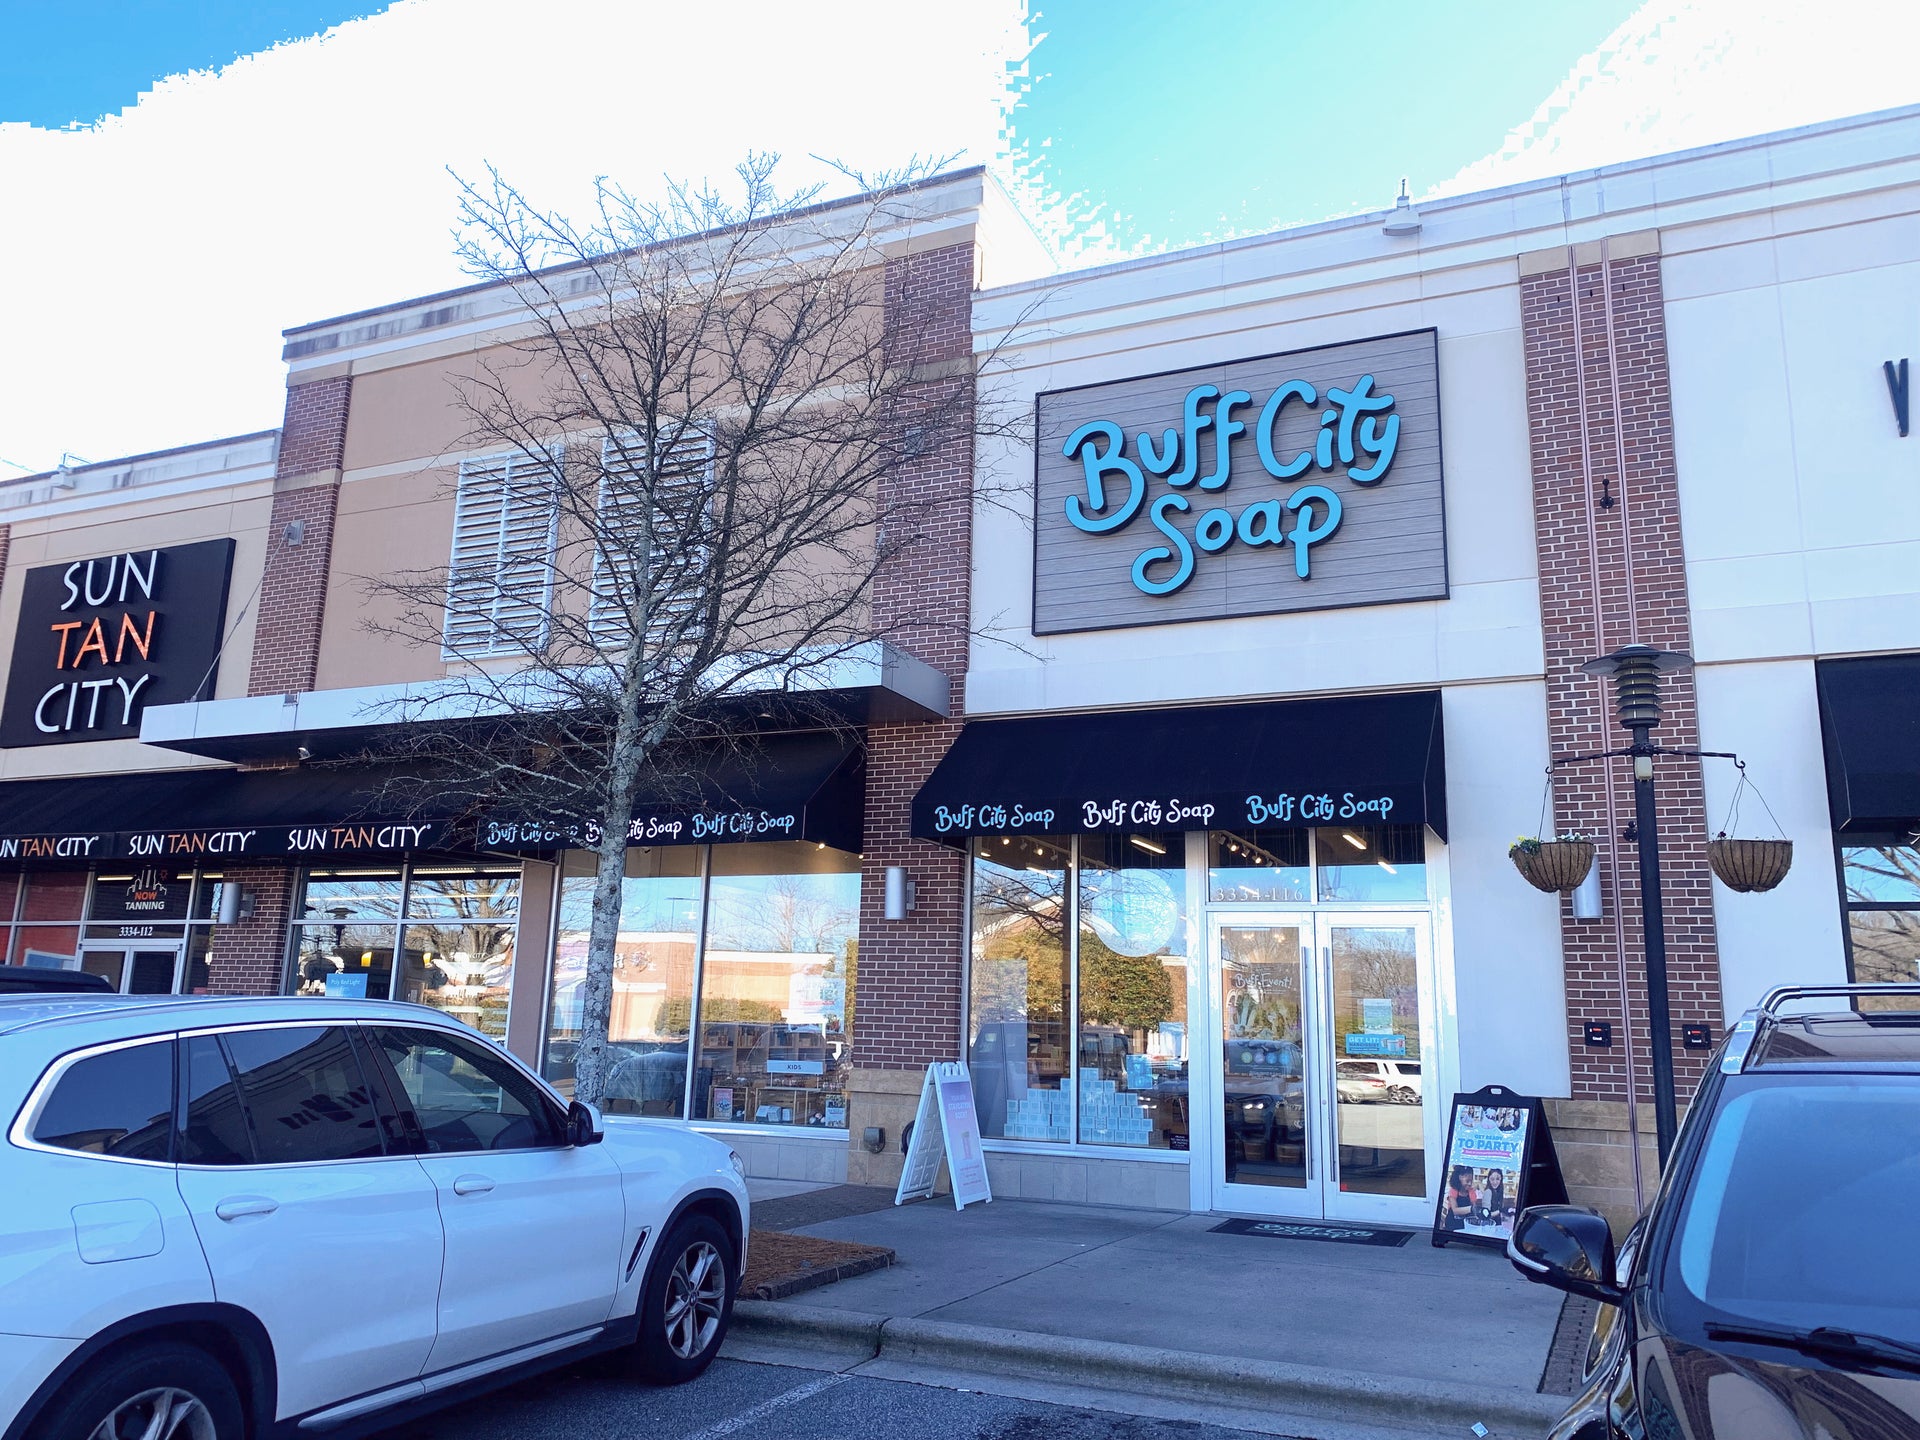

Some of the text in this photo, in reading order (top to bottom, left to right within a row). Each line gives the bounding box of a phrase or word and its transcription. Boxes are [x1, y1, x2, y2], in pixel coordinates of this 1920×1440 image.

[1062, 374, 1401, 535] Buff City
[1131, 484, 1345, 597] Soap
[61, 550, 158, 611] SUN
[51, 610, 156, 670] TAN
[34, 673, 149, 733] CITY
[934, 803, 1055, 832] Buff City Soap
[1082, 798, 1215, 829] Buff City Soap
[1246, 792, 1394, 825] Buff City Soap
[646, 817, 683, 840] Soap
[692, 813, 727, 838] Buff
[756, 811, 796, 835] Soap
[20, 837, 56, 857] TAN
[128, 835, 165, 855] SUN
[168, 833, 206, 853] TAN
[287, 829, 327, 850] SUN
[331, 827, 375, 848] TAN
[125, 901, 165, 910] TANNING
[134, 891, 157, 900] NOW
[1217, 888, 1303, 901] 3334-116
[118, 926, 153, 937] 3334-112
[1235, 972, 1292, 988] Buff Event!
[1457, 1137, 1475, 1149] TO
[1477, 1139, 1519, 1153] PARTY
